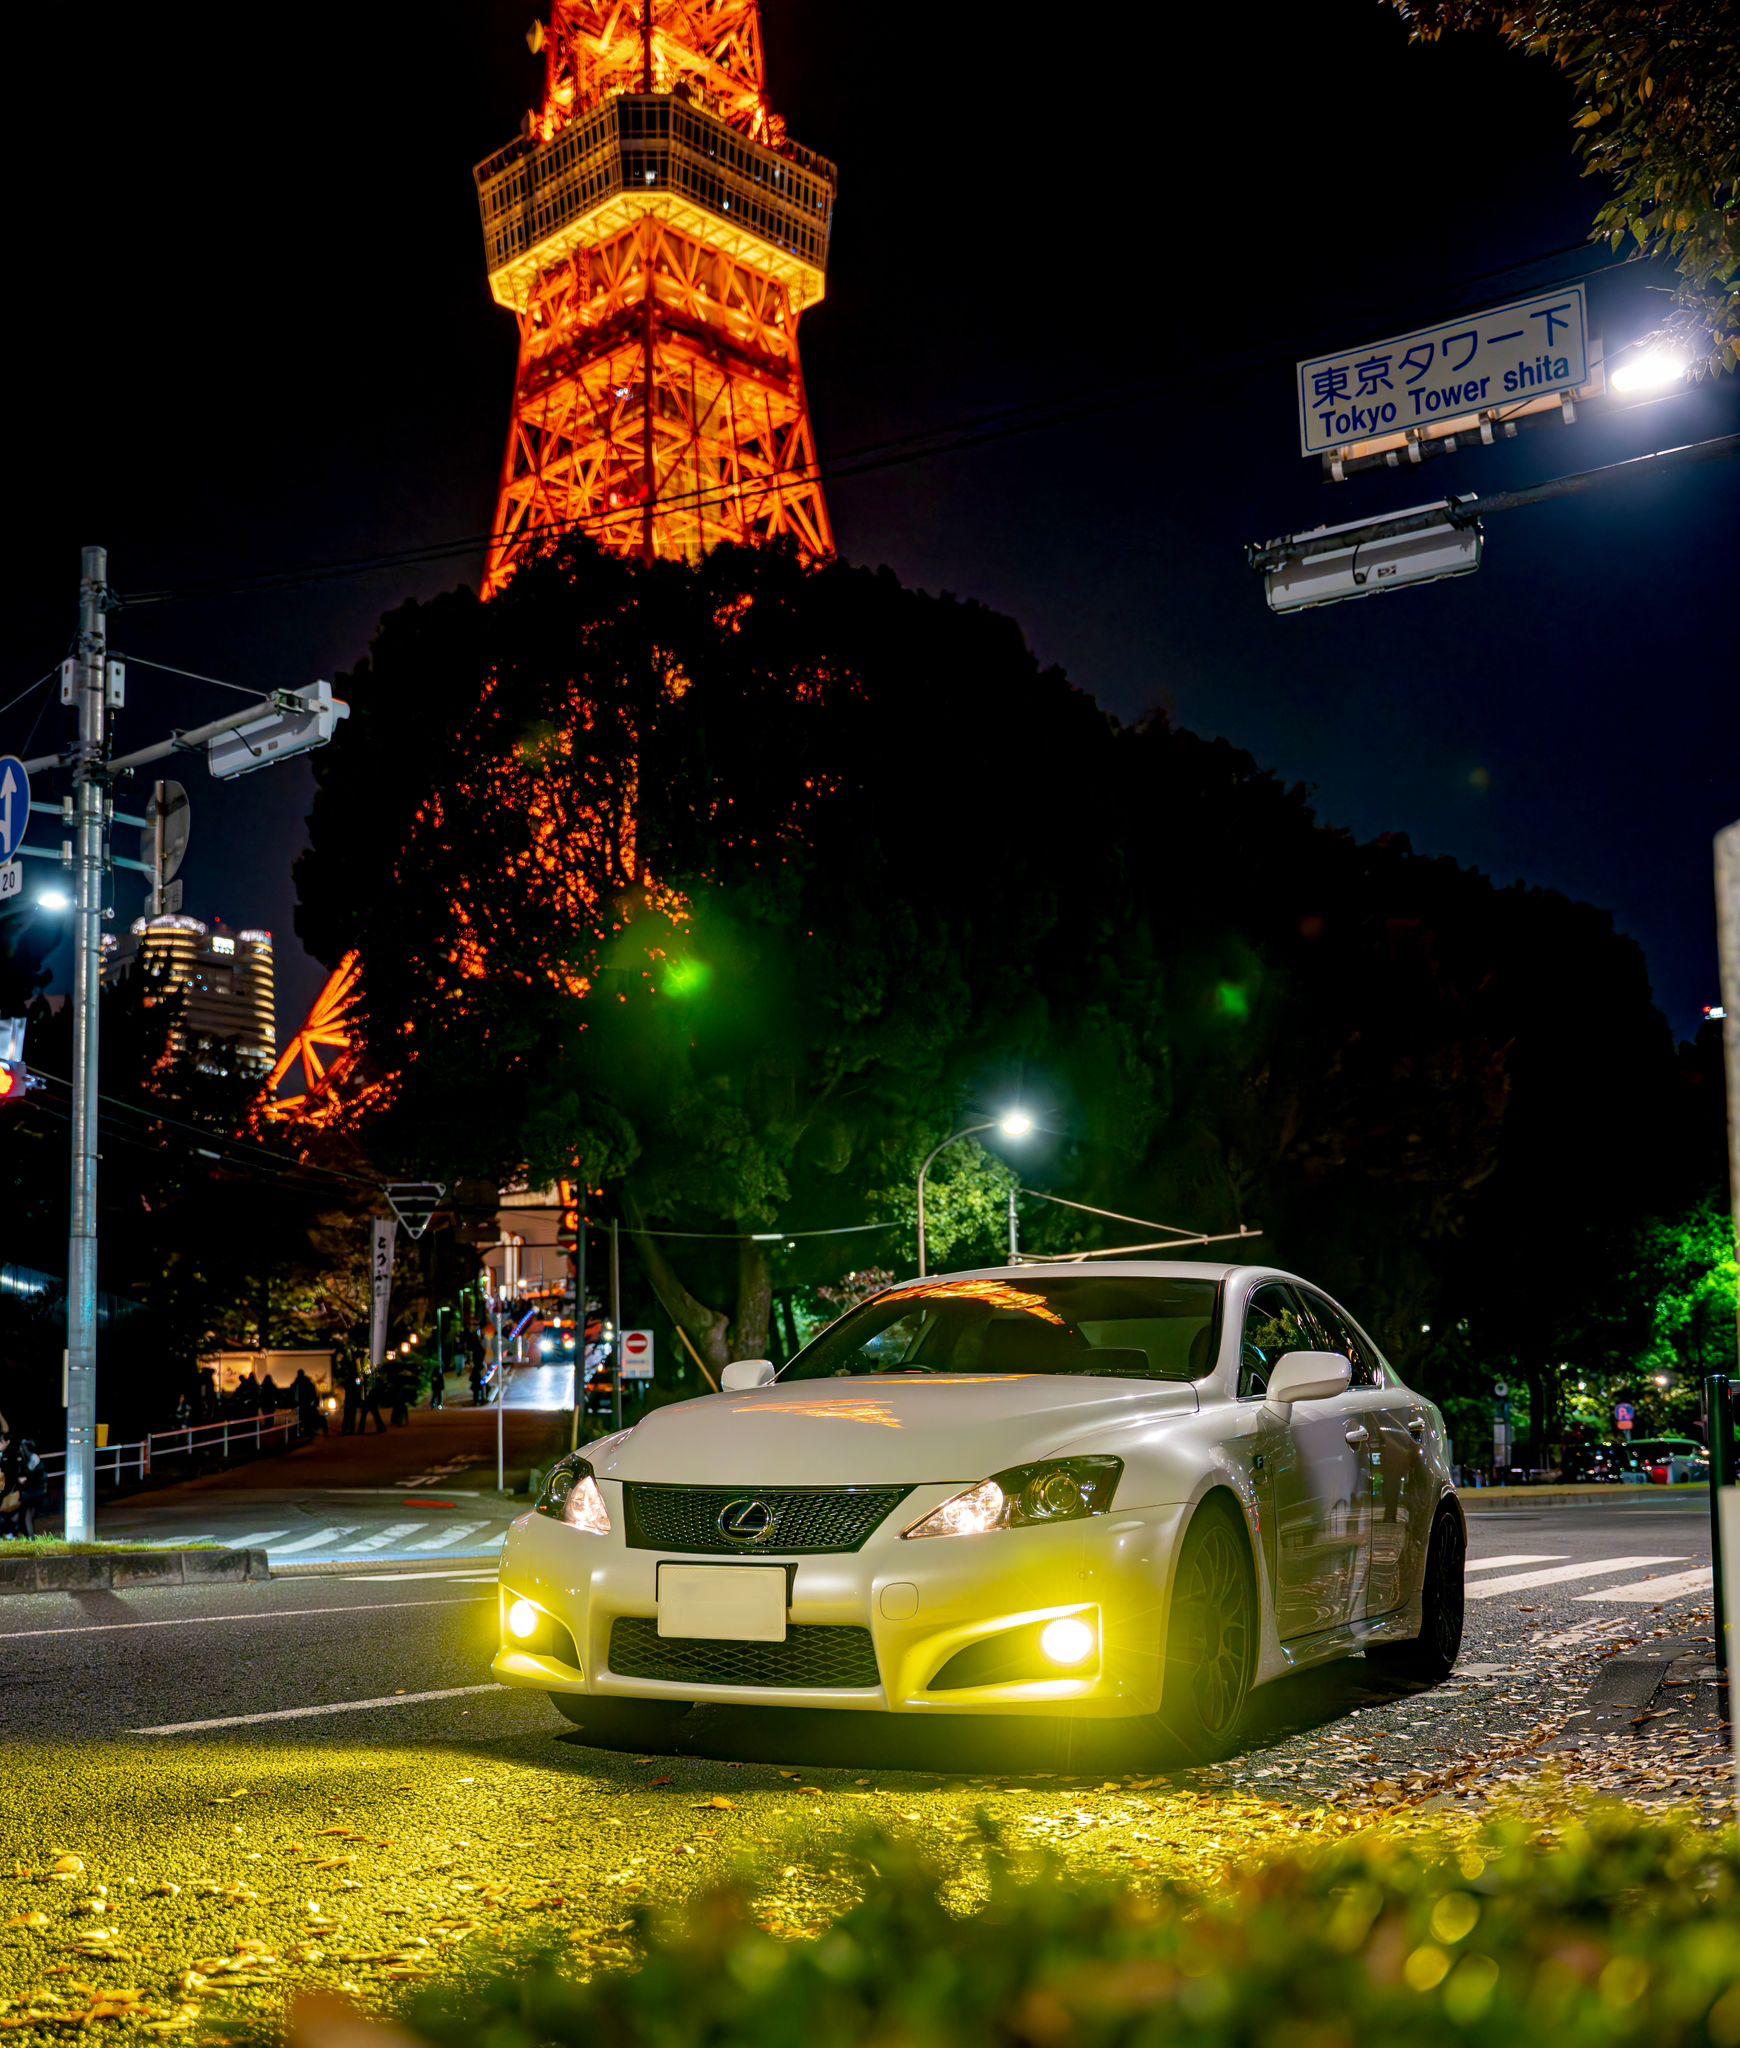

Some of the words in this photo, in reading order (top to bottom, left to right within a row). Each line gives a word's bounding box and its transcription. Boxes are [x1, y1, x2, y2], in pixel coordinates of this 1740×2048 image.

[1312, 303, 1572, 409] 東京タワー下
[1318, 401, 1398, 438] Tokyo
[1407, 375, 1491, 416] Tower
[1503, 354, 1570, 393] shita
